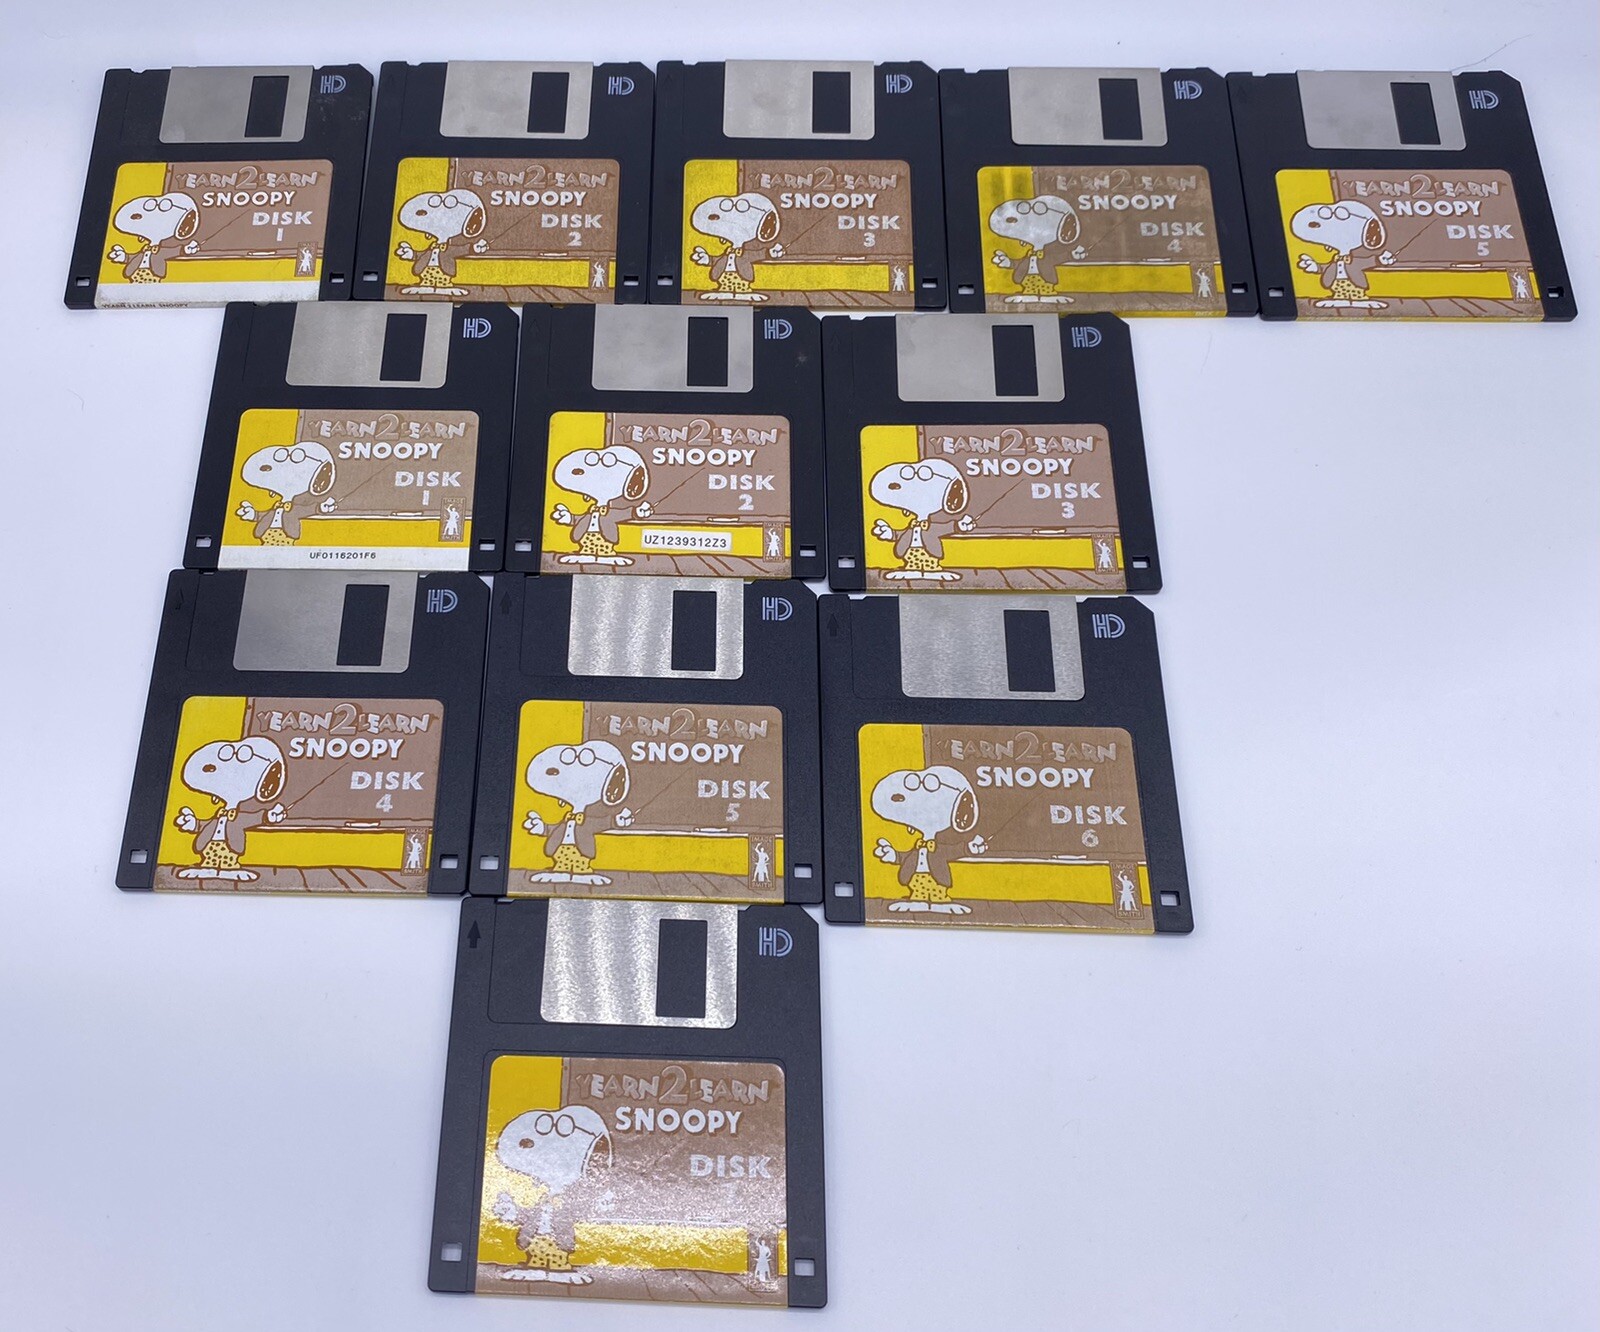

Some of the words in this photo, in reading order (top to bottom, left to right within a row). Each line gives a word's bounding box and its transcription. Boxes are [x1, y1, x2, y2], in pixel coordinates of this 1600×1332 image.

[320, 75, 347, 93] HD
[608, 76, 635, 96] HD
[886, 74, 913, 94] HD
[1174, 80, 1202, 100] HD
[1469, 90, 1499, 110] HD
[202, 191, 296, 207] SNOOPY
[490, 190, 587, 206] SNOOPY
[780, 193, 877, 209] SNOOPY
[1078, 195, 1177, 211] SNOOPY
[252, 211, 313, 225] DISK
[1381, 201, 1482, 217] SNOOPY
[541, 214, 602, 229] DISK
[838, 215, 900, 230] DISK
[1140, 222, 1205, 237] DISK
[567, 233, 582, 247] 2
[863, 233, 875, 247] 3
[1446, 224, 1514, 240] DISK
[1167, 239, 1182, 252] 4
[1477, 242, 1490, 257] 5
[463, 317, 491, 338] HD
[764, 319, 793, 340] HD
[1071, 327, 1102, 348] HD
[338, 442, 443, 460] SNOOPY
[652, 448, 756, 466] SNOOPY
[966, 458, 1073, 476] SNOOPY
[394, 471, 461, 487] DISK
[708, 474, 775, 491] DISK
[1031, 483, 1101, 499] DISK
[738, 494, 754, 511] 2
[1062, 502, 1075, 519] 3
[644, 535, 727, 548] UZ1239312Z3
[426, 589, 458, 613] HD
[762, 597, 793, 621] HD
[1092, 614, 1126, 639] HD
[257, 711, 332, 732] YEARN
[359, 714, 429, 734] LEARN
[289, 738, 404, 758] SNOOPY
[631, 742, 744, 764] SNOOPY
[350, 771, 424, 790] DISK
[976, 767, 1094, 788] SNOOPY
[698, 779, 771, 800] DISK
[375, 794, 393, 813] 4
[726, 803, 740, 822] 5
[1050, 805, 1127, 825] DISK
[1082, 830, 1099, 847] 6
[758, 926, 793, 957] HD
[615, 1106, 742, 1134] SNOOPY
[689, 1154, 771, 1179] DISK
